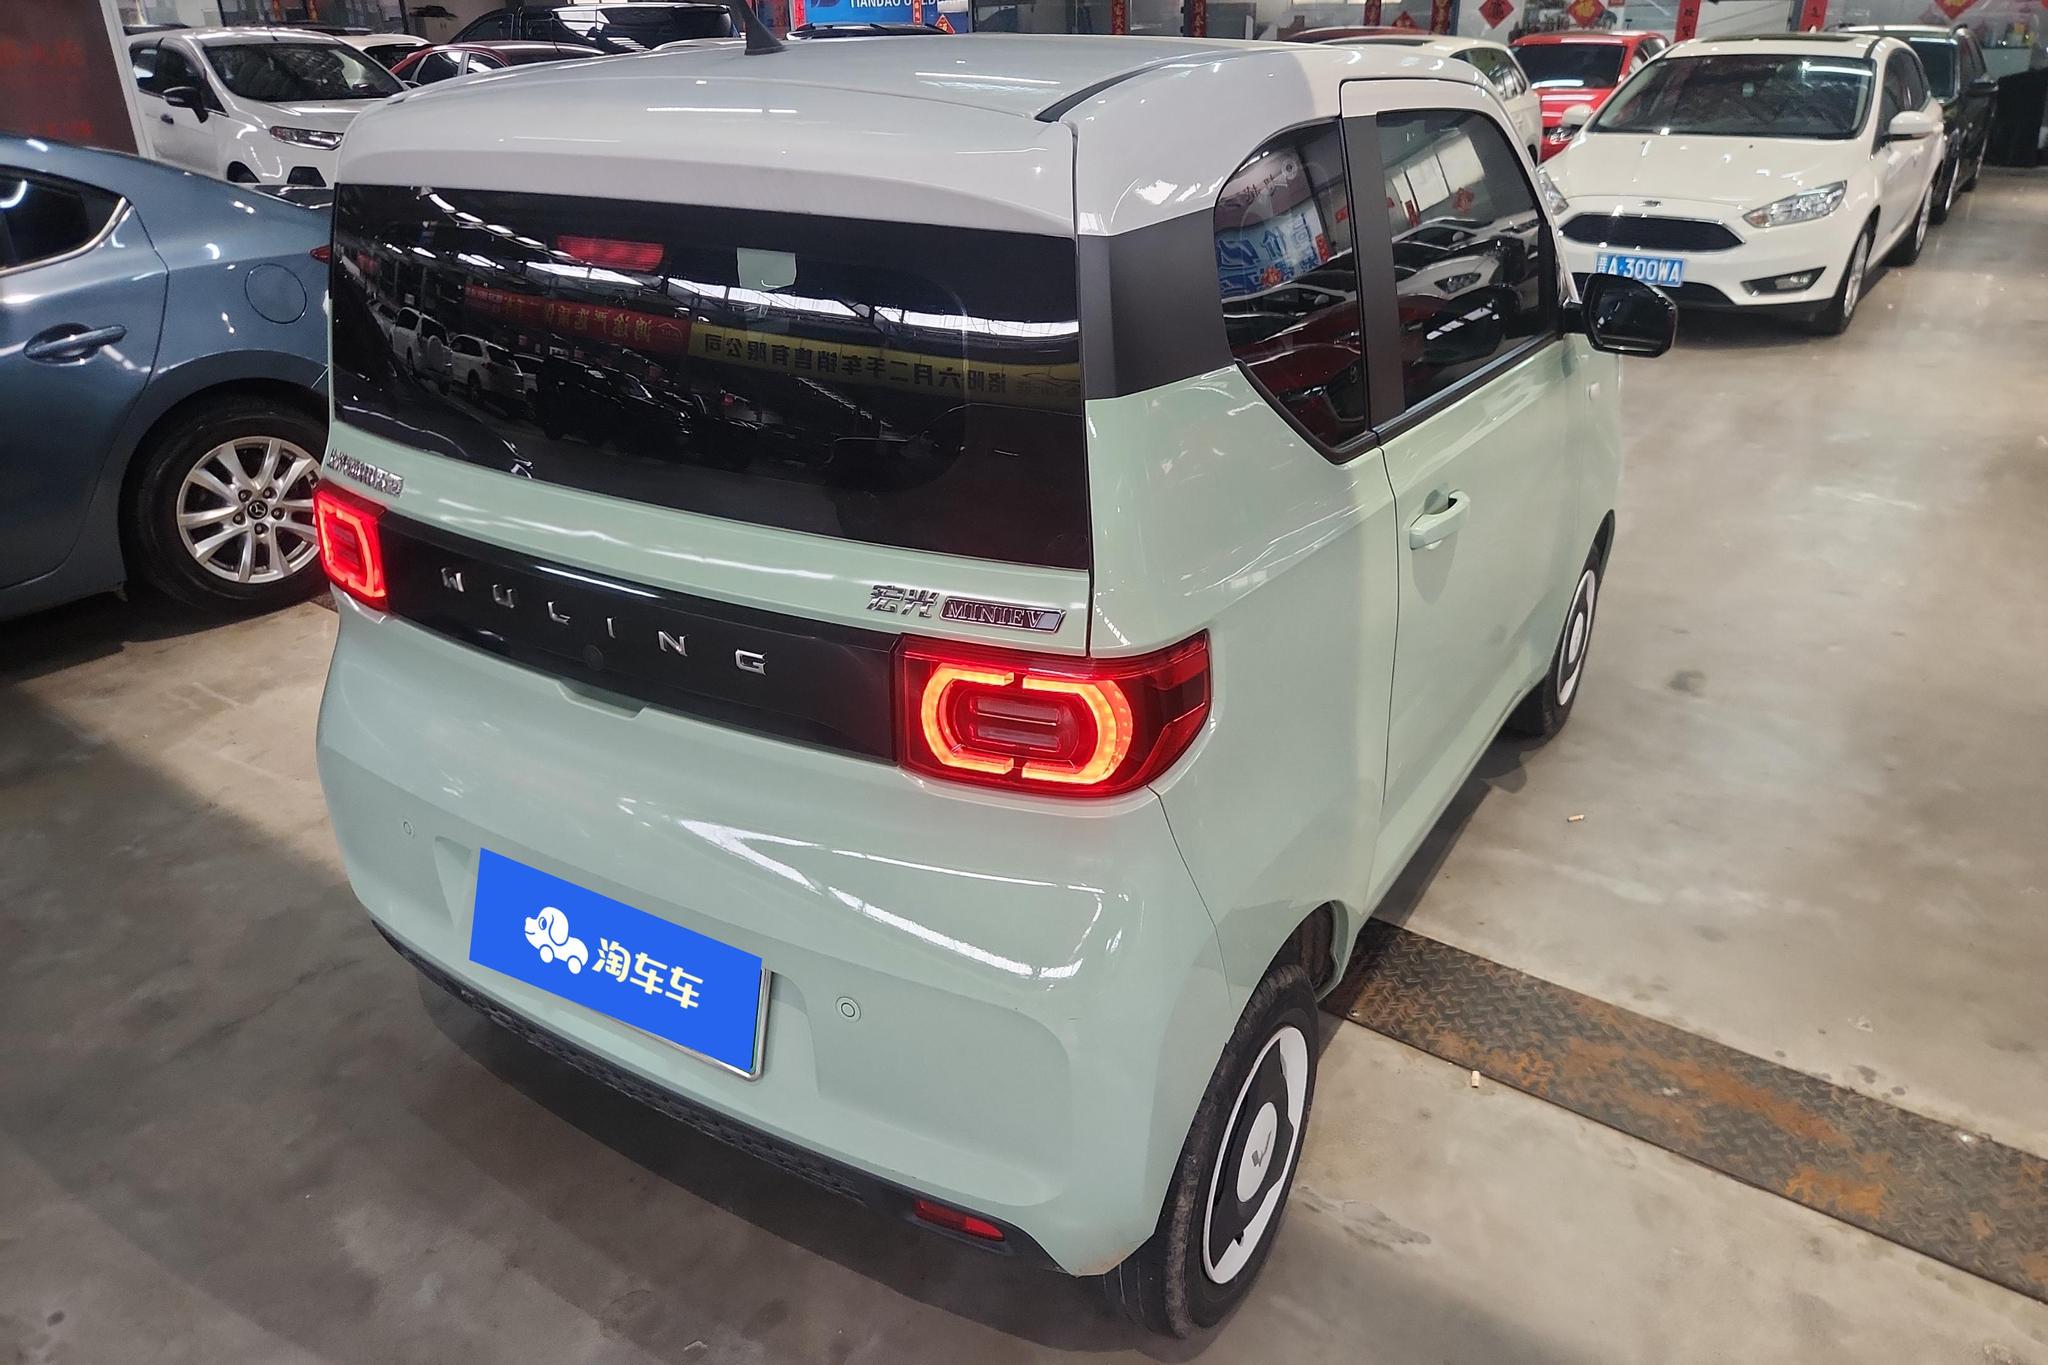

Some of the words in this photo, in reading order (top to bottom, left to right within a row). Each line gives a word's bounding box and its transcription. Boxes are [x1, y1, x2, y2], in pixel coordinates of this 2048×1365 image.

[441, 567, 768, 677] WULING
[866, 584, 939, 618] 宏光
[945, 600, 1045, 628] MINIEV
